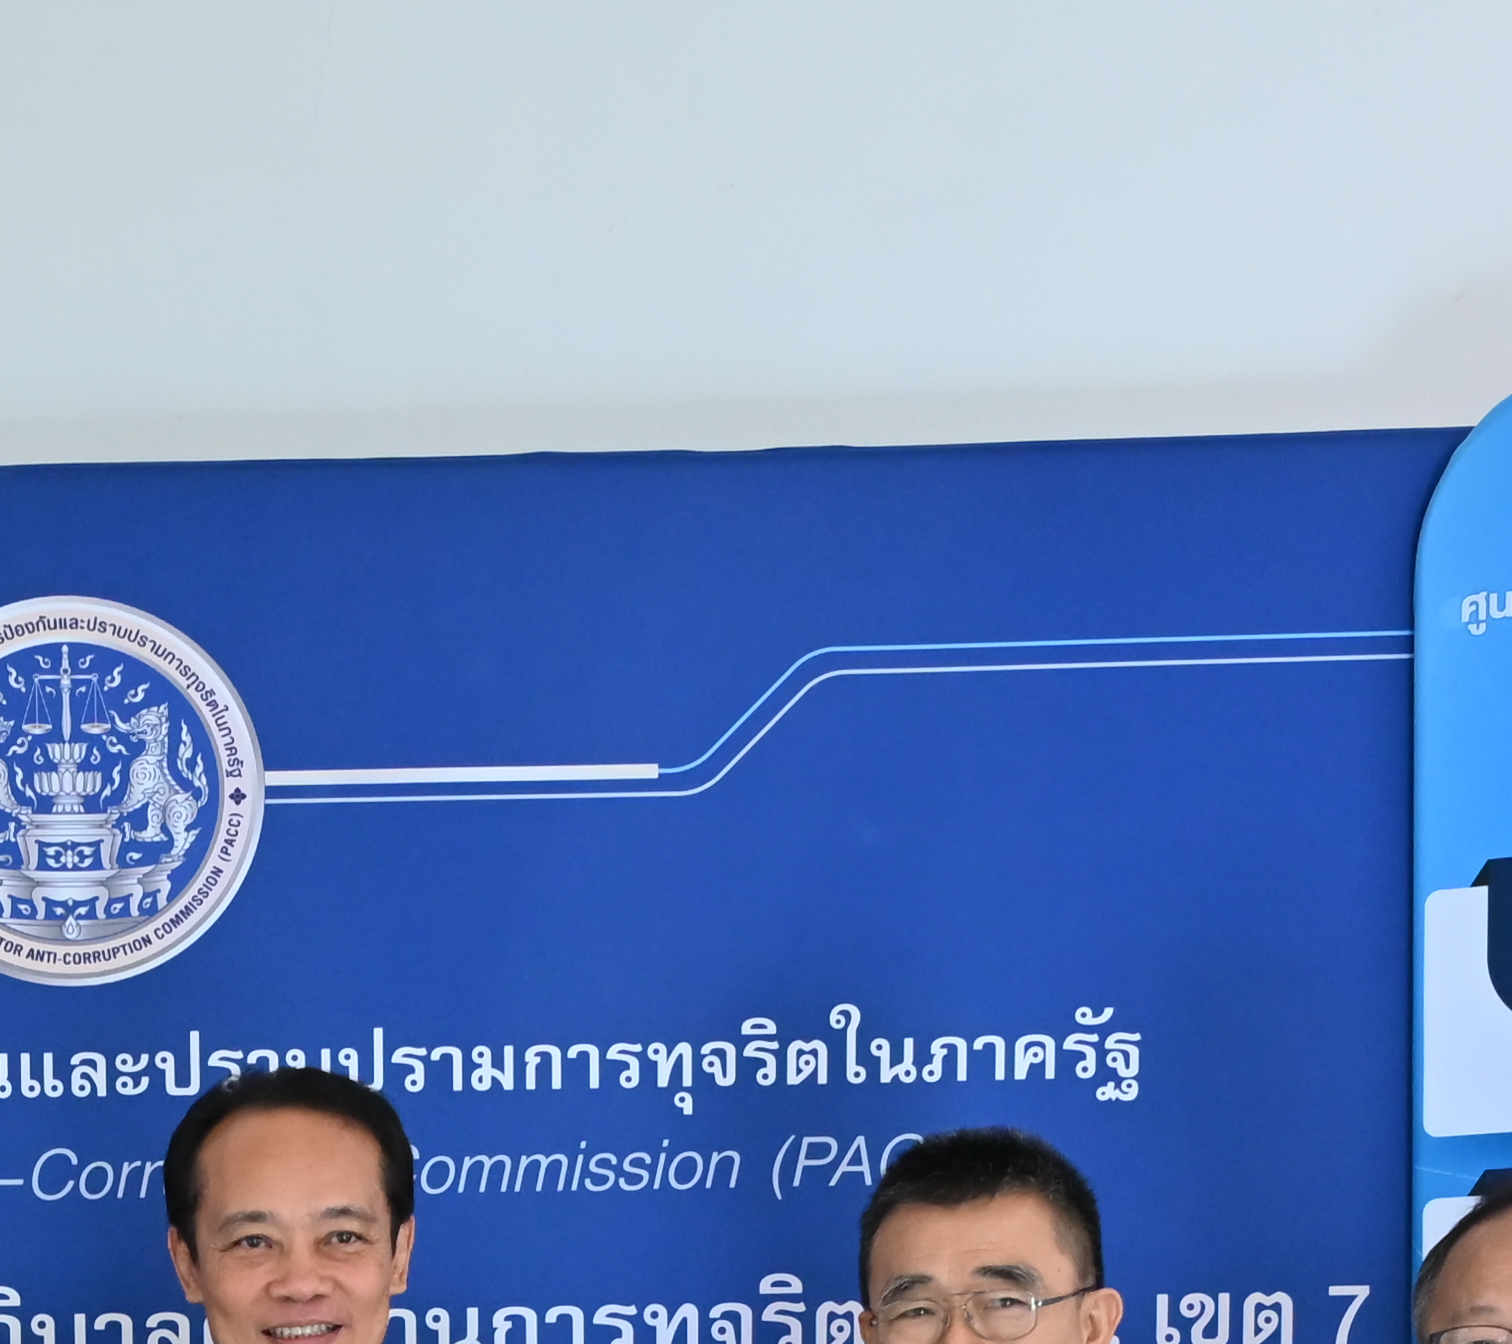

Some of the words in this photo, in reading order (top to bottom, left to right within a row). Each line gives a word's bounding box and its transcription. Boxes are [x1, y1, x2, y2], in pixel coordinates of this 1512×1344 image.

[24, 934, 154, 967] ANTI-CORRUPTION
[153, 868, 224, 941] COMMISSION
[219, 811, 245, 864] (PACC)
[411, 1138, 741, 1196] ommission
